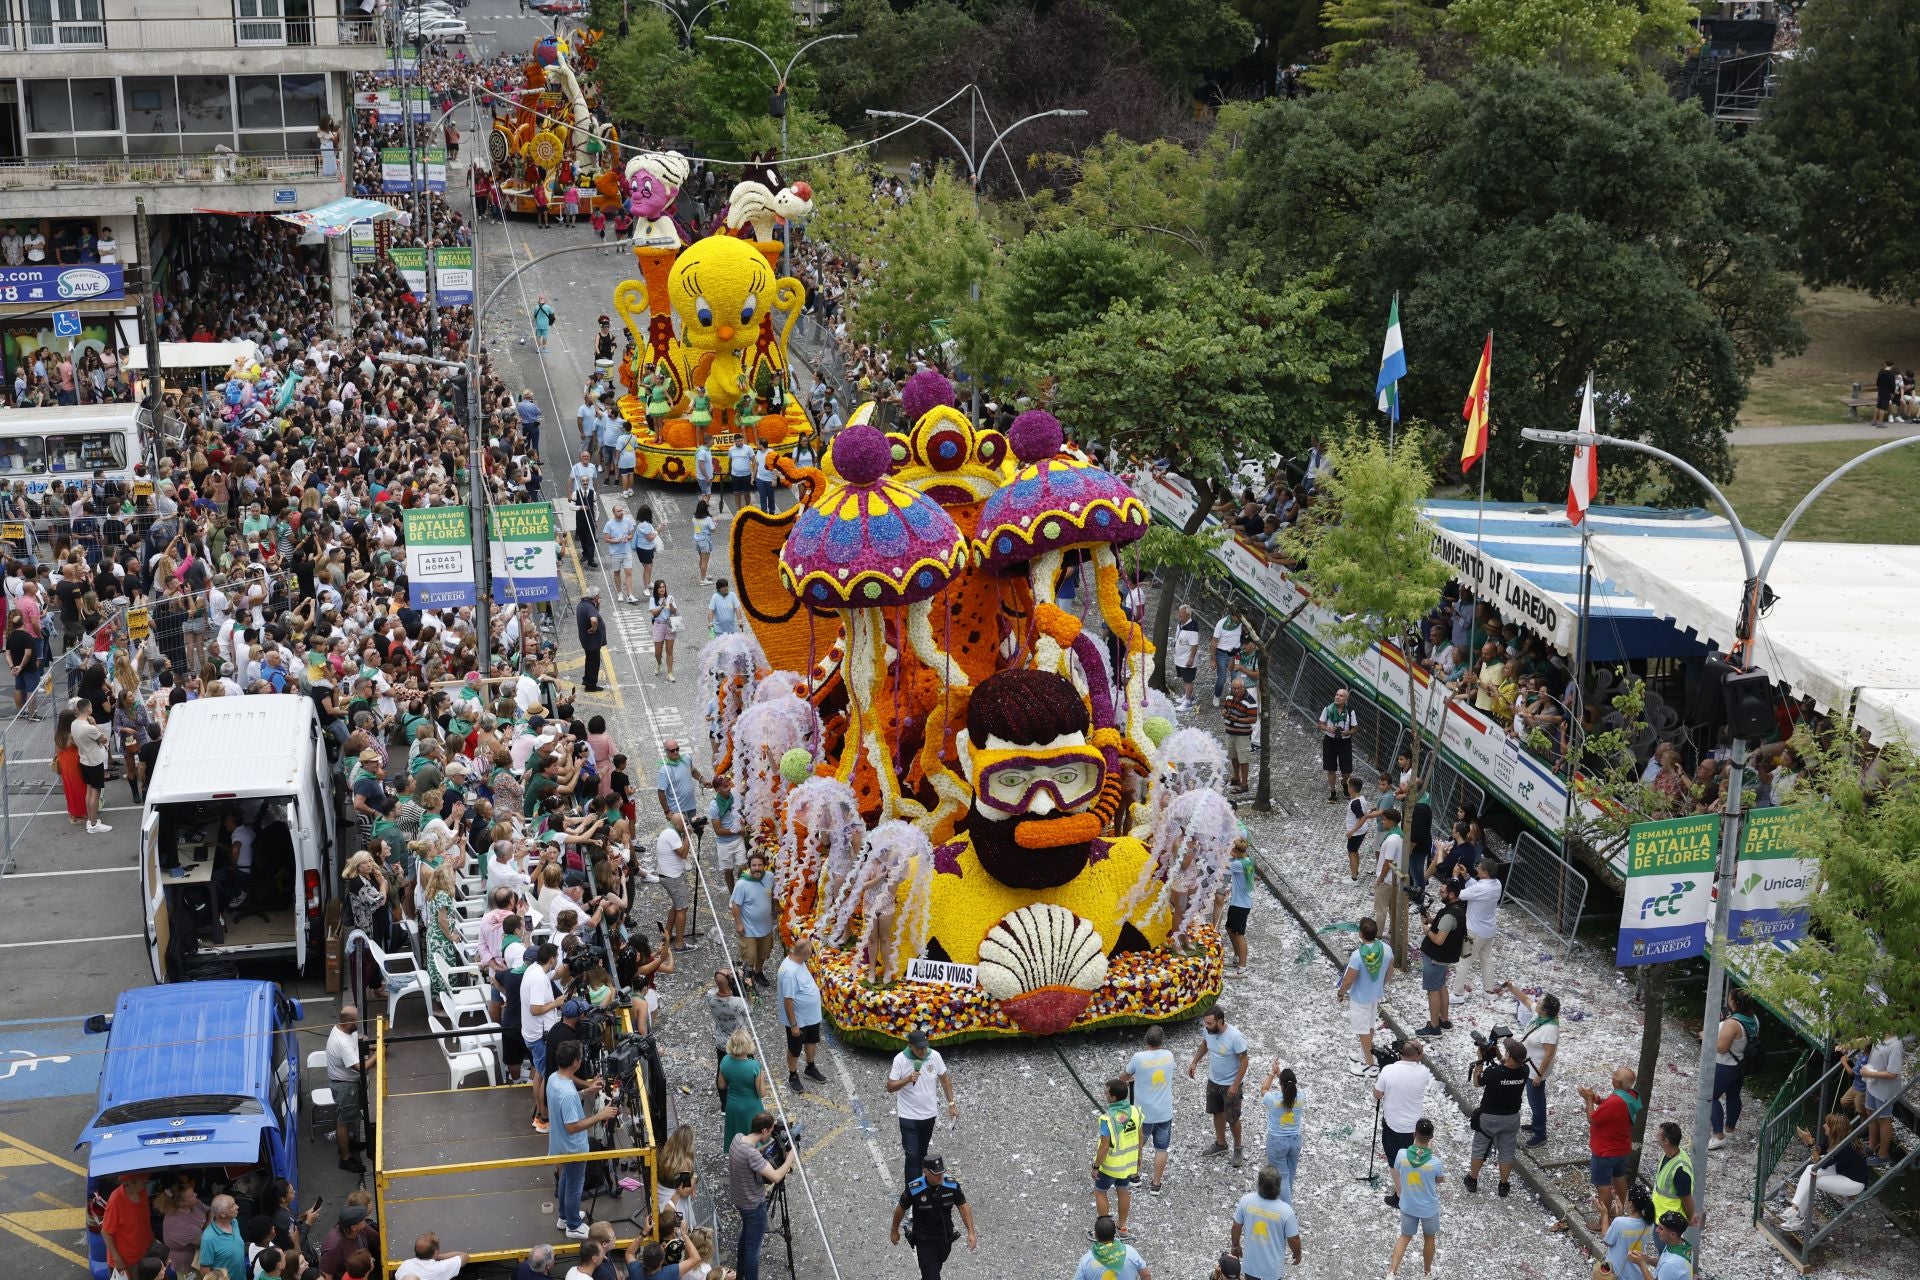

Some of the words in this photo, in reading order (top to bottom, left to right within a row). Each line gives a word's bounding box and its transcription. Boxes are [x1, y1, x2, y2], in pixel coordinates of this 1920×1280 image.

[409, 514, 436, 522] SEMANA
[409, 520, 466, 533] BATALLA
[510, 524, 549, 536] FLORES
[410, 532, 423, 541] DE
[426, 528, 466, 540] FLORES
[425, 556, 456, 564] AEDAS
[425, 563, 456, 571] HOMES
[430, 593, 465, 603] LAREDO
[1489, 566, 1504, 597] DE
[1505, 579, 1557, 632] LAREDO
[1472, 744, 1490, 766] Unicaja
[1751, 815, 1787, 826] SEMANA
[1636, 829, 1674, 840] SEMANA
[1676, 823, 1713, 835] GRANDE
[1634, 833, 1711, 858] BATALLA
[1744, 841, 1763, 854] DE
[1634, 855, 1652, 870] DE
[1656, 847, 1711, 866] FLORES
[1640, 892, 1684, 921] FCC
[1646, 940, 1692, 956] LAREDO
[946, 965, 973, 985] VIVAS
